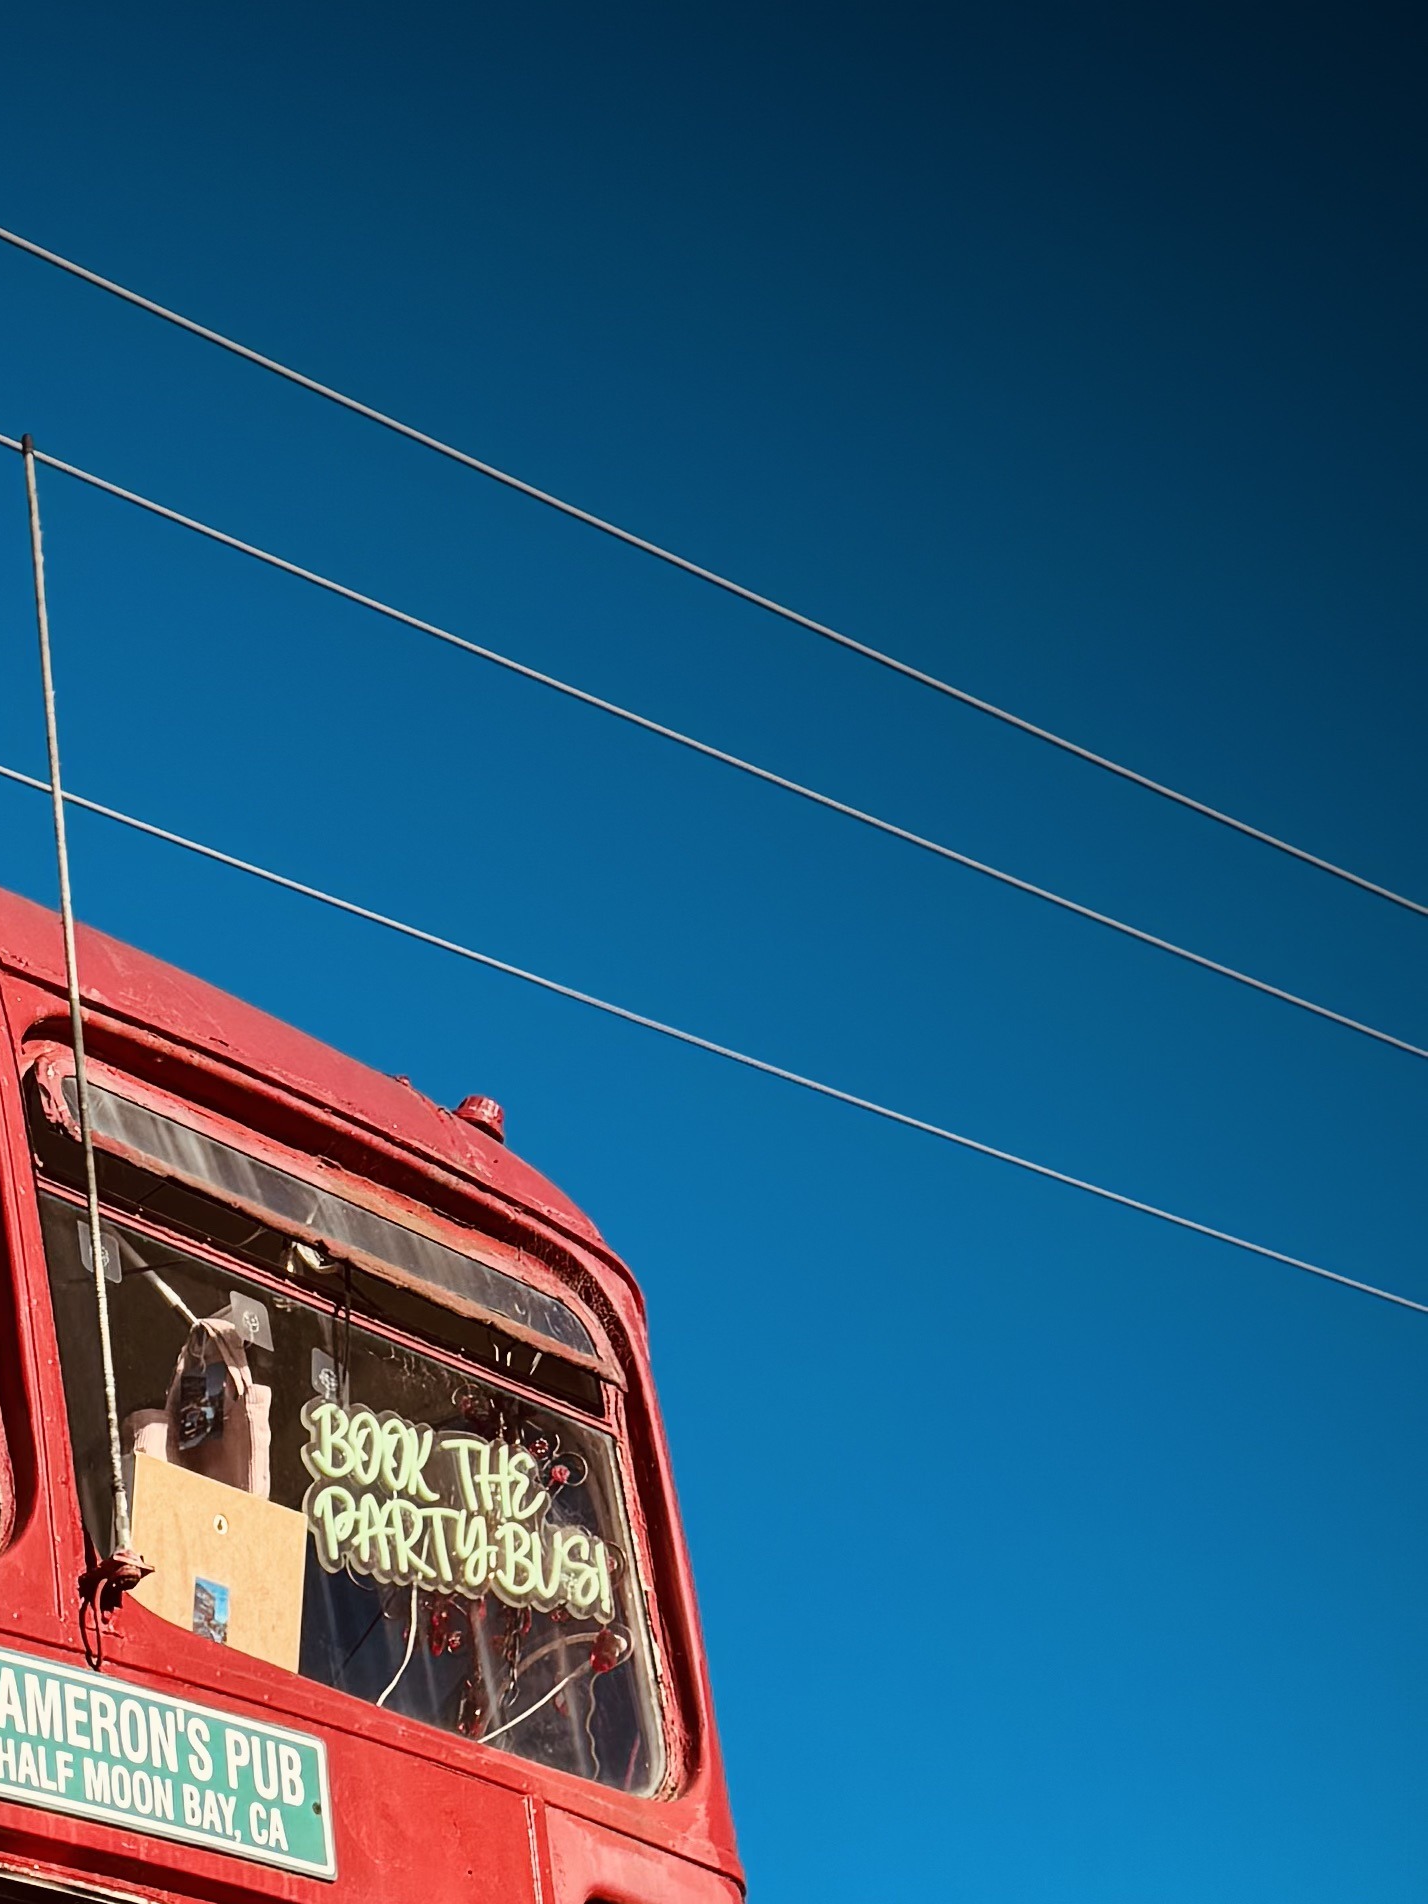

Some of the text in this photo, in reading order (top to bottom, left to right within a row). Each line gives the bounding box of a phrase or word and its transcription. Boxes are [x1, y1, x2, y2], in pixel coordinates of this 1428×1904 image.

[311, 1403, 546, 1520] BOOK THE
[313, 1486, 612, 1614] PARTY BUS!
[83, 1757, 174, 1820] MOON
[182, 1783, 242, 1843] BAY,
[249, 1802, 289, 1851] CA
[224, 1728, 305, 1806] PUB
